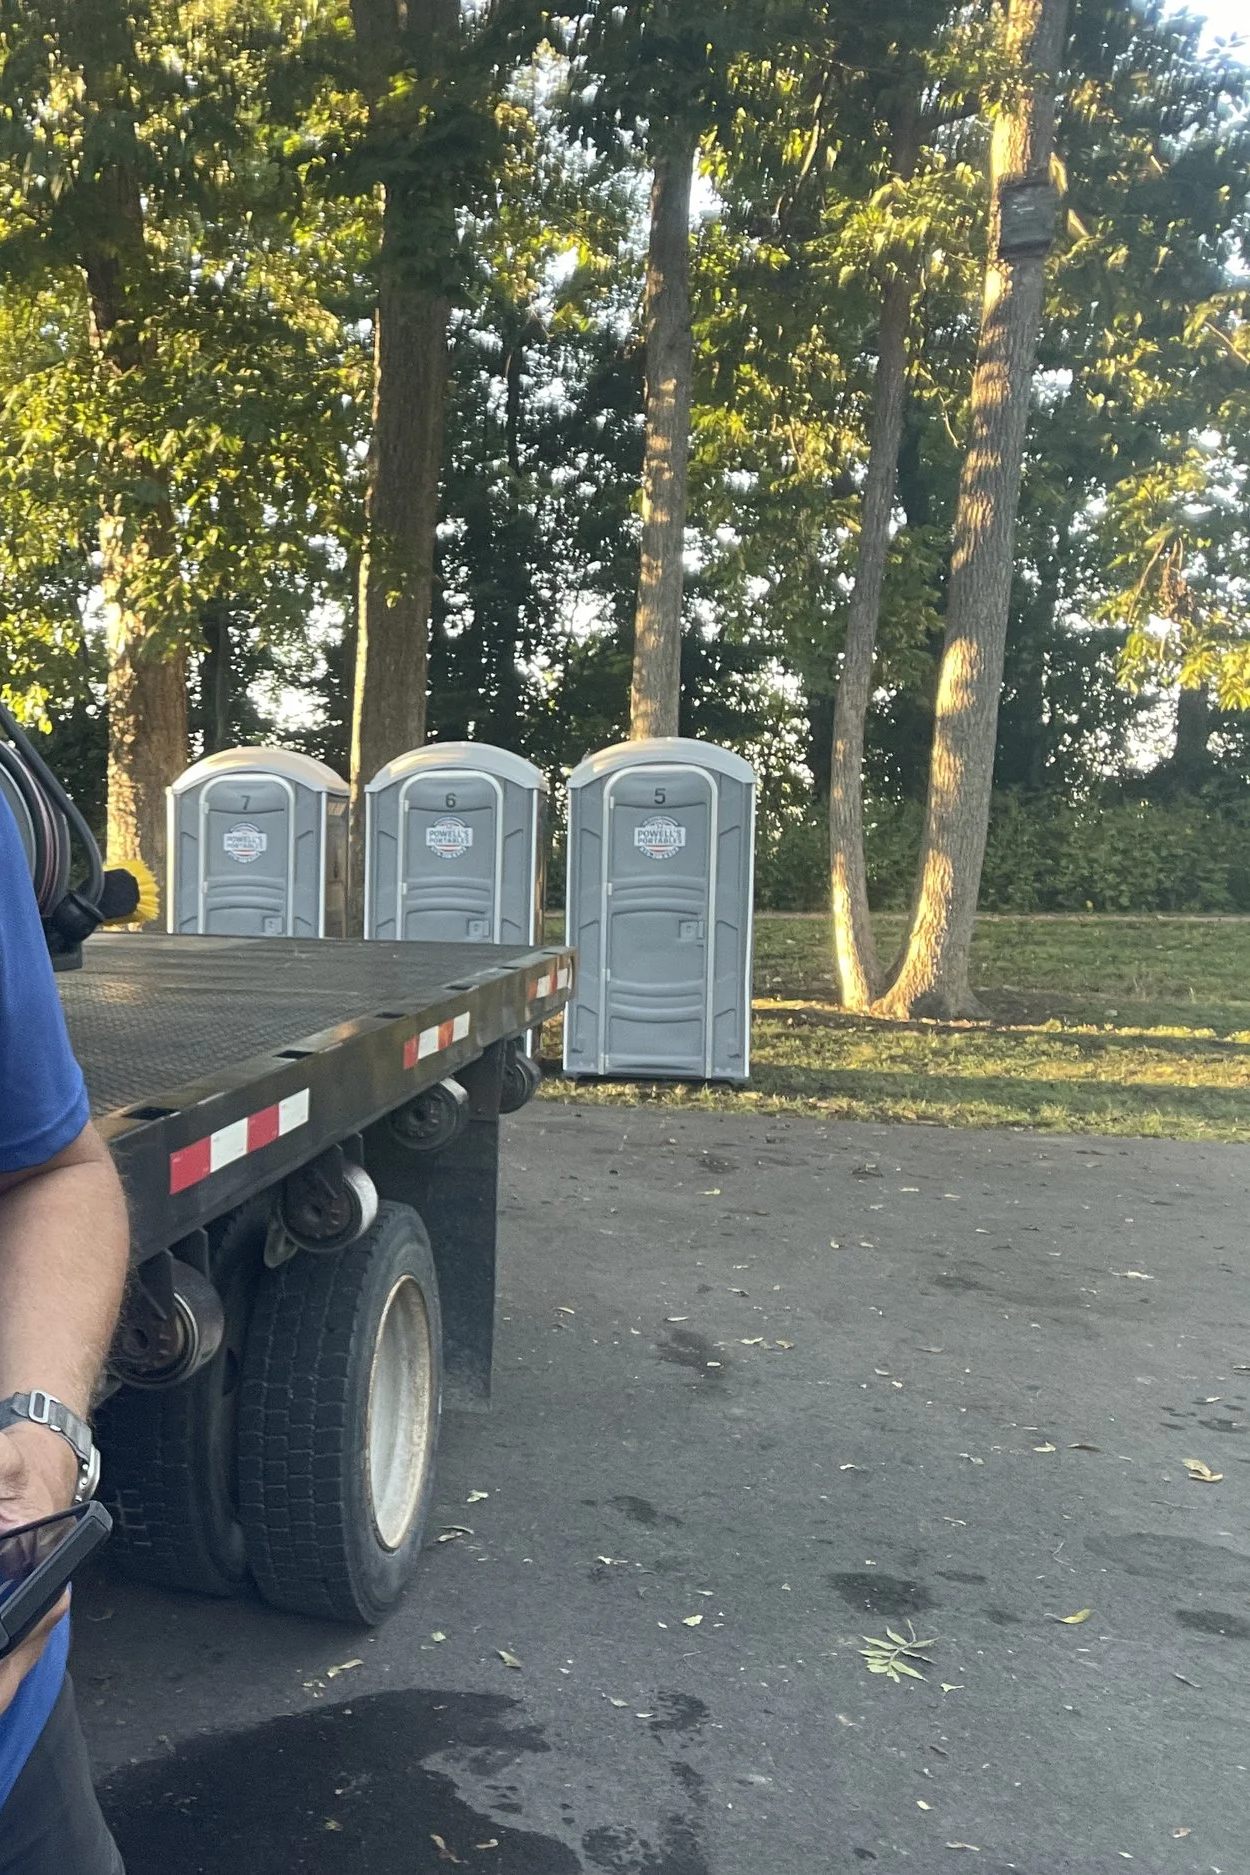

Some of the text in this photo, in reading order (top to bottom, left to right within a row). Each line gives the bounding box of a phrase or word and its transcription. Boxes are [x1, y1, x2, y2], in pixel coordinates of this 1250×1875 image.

[241, 795, 251, 811] 7
[445, 792, 457, 808] 6
[653, 788, 666, 805] 5
[637, 829, 682, 838] POWELL'S
